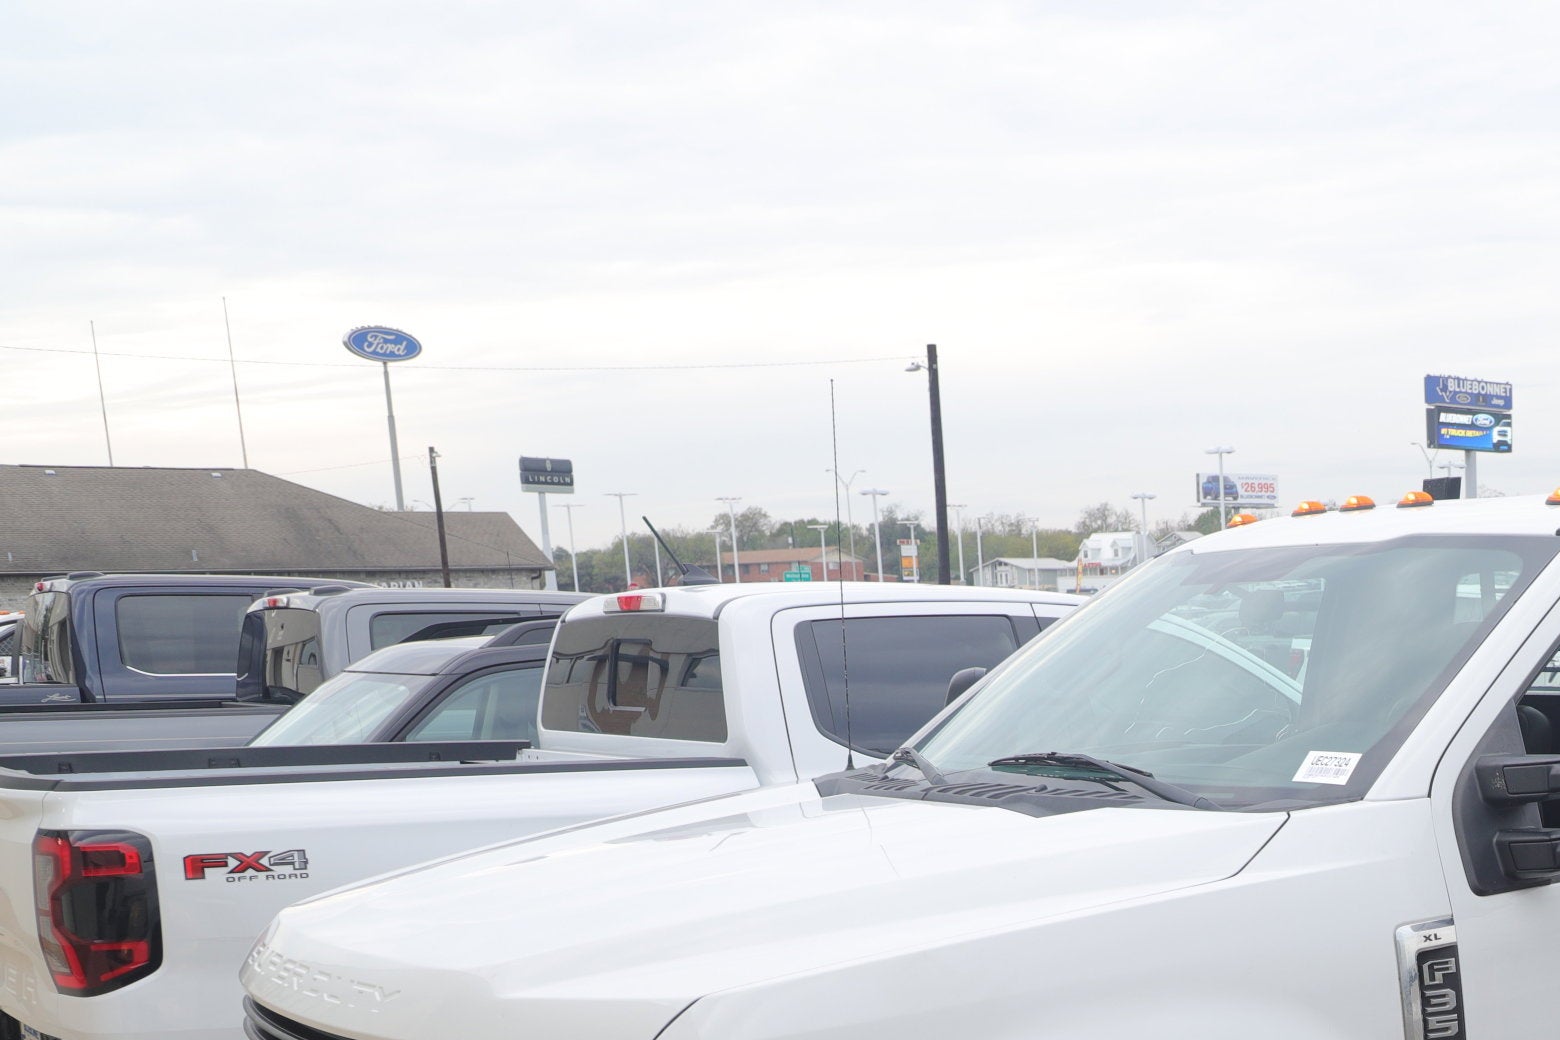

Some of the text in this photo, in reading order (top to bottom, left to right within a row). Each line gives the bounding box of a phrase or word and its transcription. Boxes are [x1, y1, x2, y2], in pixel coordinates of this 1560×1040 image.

[364, 332, 407, 356] Ford
[1447, 378, 1511, 397] BLUEBONNET
[528, 474, 571, 484] LINCOLN
[1241, 482, 1275, 493] $26,995
[183, 849, 308, 880] FX4
[226, 872, 309, 883] OFF ROAD
[1423, 933, 1442, 942] XL
